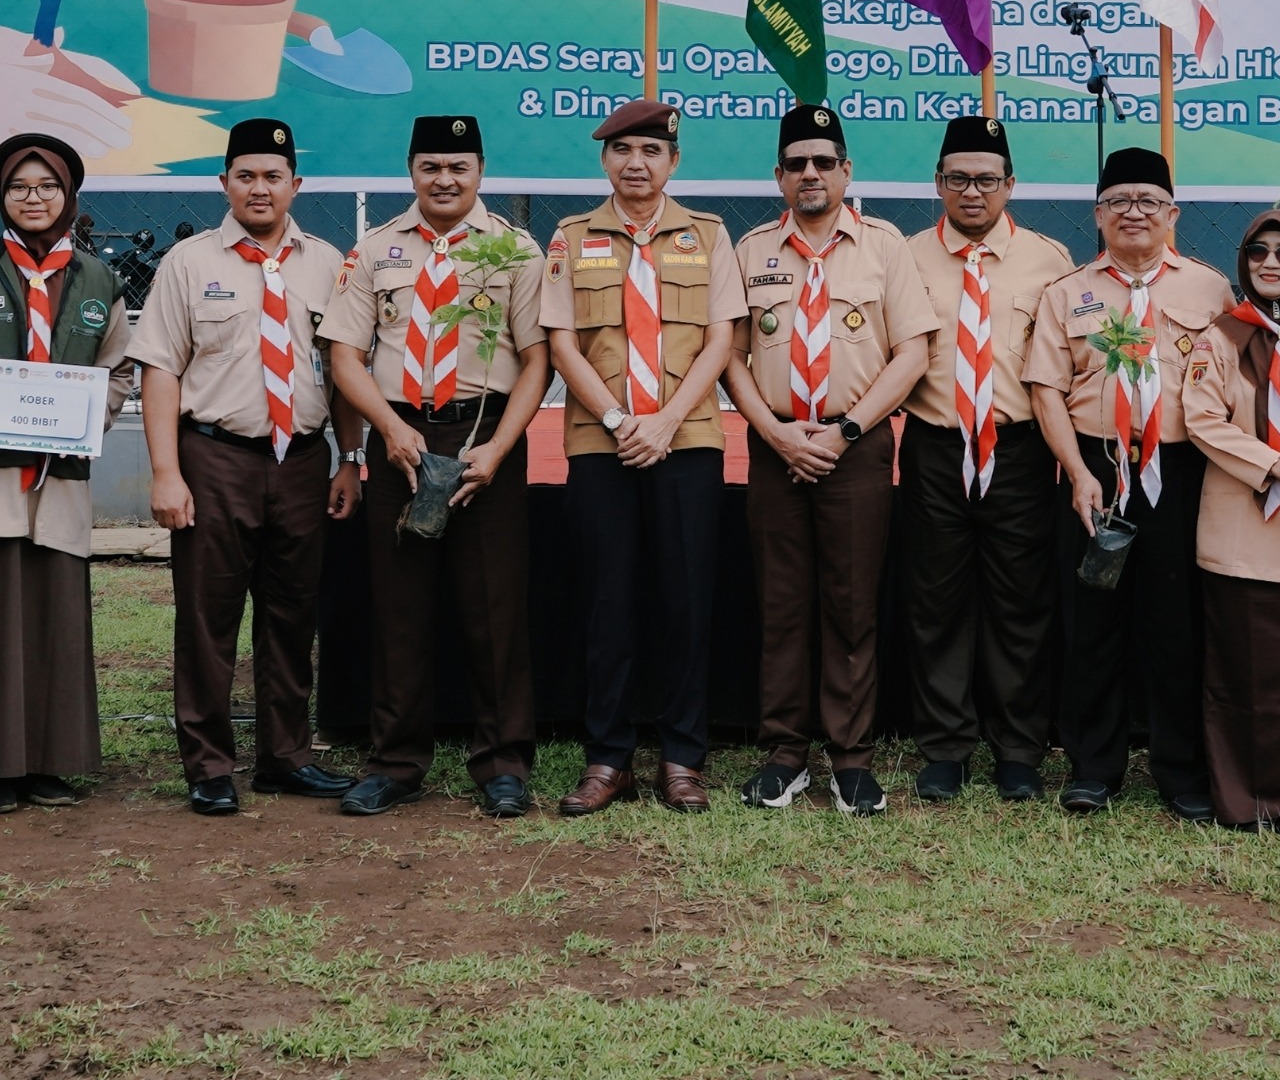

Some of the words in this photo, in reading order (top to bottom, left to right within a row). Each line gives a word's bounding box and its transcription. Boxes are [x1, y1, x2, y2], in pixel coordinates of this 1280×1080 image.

[427, 43, 549, 71] BPDAS
[558, 44, 675, 78] Serayu
[825, 50, 901, 79] ogo,
[910, 42, 1012, 76] Dins
[519, 89, 544, 117] &
[555, 88, 643, 117] Dina
[661, 89, 830, 119] Pertania
[840, 89, 898, 120] dan
[752, 275, 788, 285] FAHMI.A
[19, 394, 55, 407] KOBER
[10, 415, 31, 426] 400
[32, 416, 59, 428] BIBIT
